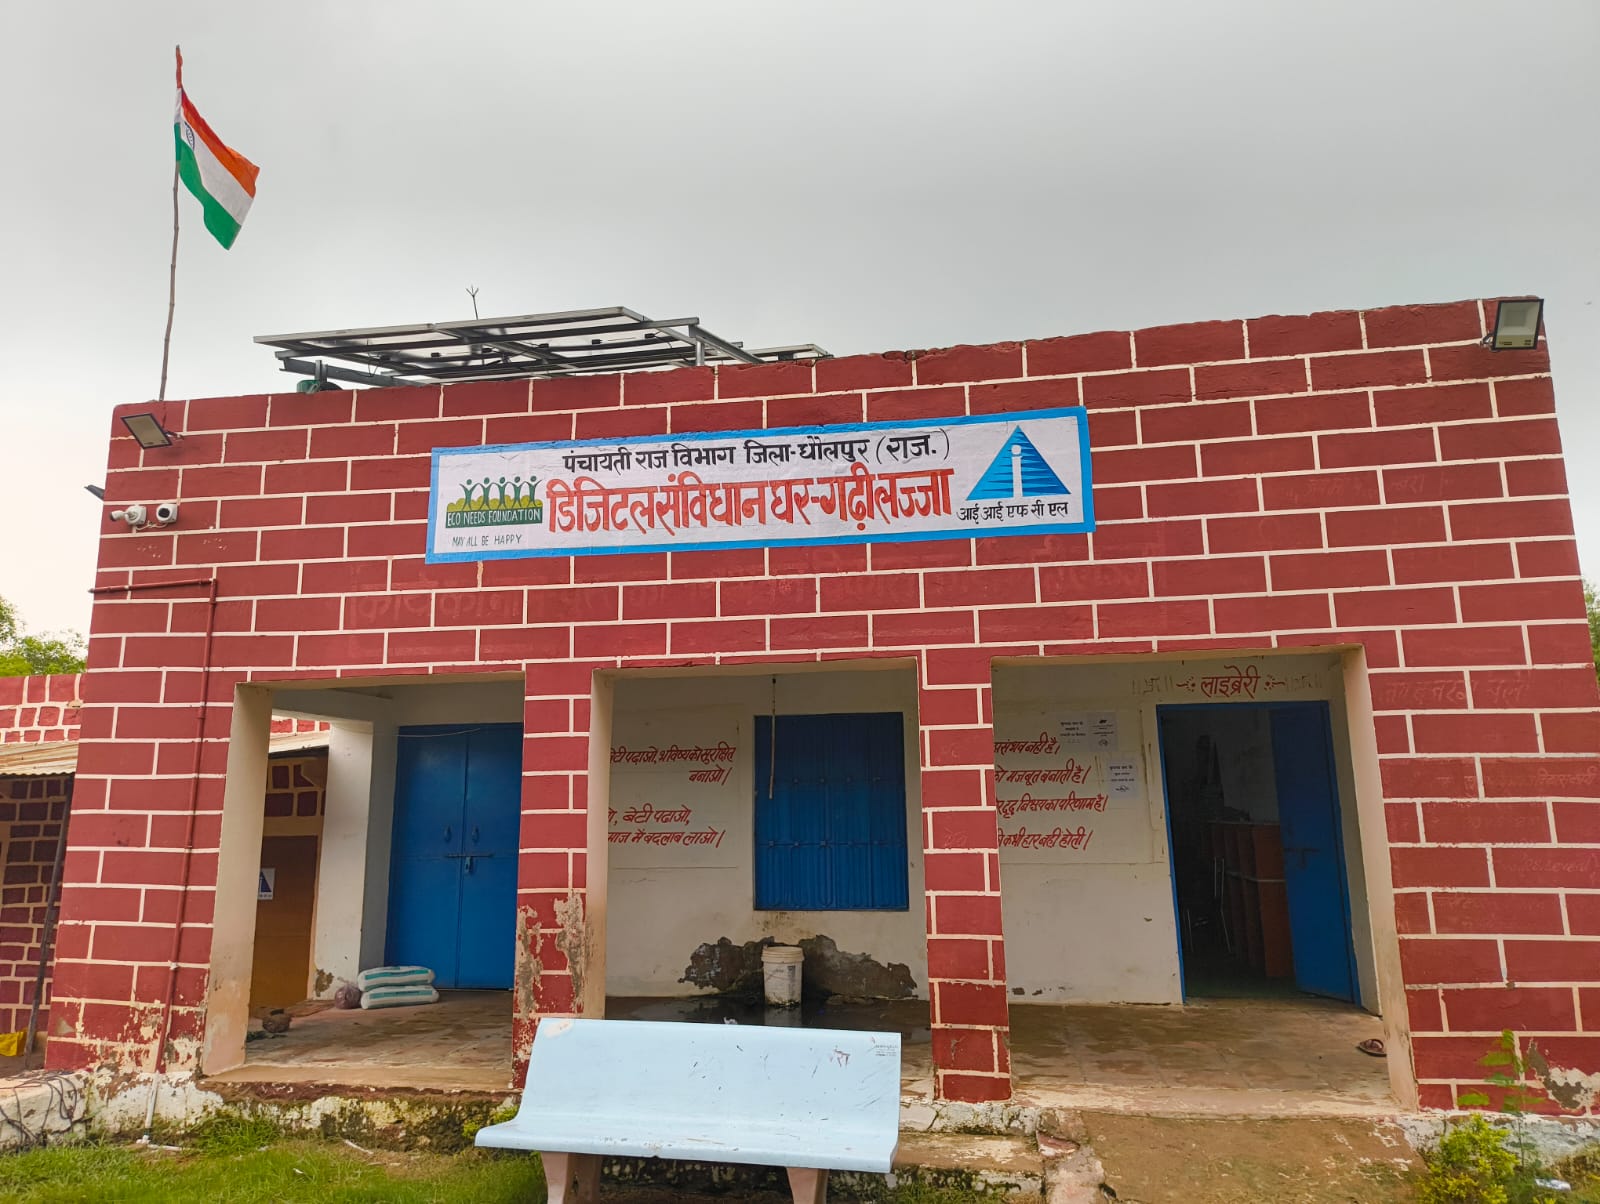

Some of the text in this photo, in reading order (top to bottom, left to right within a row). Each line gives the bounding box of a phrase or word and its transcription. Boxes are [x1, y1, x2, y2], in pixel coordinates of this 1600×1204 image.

[562, 447, 632, 475] पंचायती
[635, 450, 669, 469] राज
[671, 443, 736, 467] विभाग
[447, 508, 541, 527] ECO NEEDS FOUNDATION
[956, 500, 1069, 524] आई आई एफ सी एल
[466, 535, 478, 547] ALL
[481, 535, 489, 546] BE
[494, 533, 522, 545] HAPPY
[1200, 664, 1262, 699] लाइब्रेरी
[623, 803, 654, 824] बेटी
[632, 828, 646, 843] में
